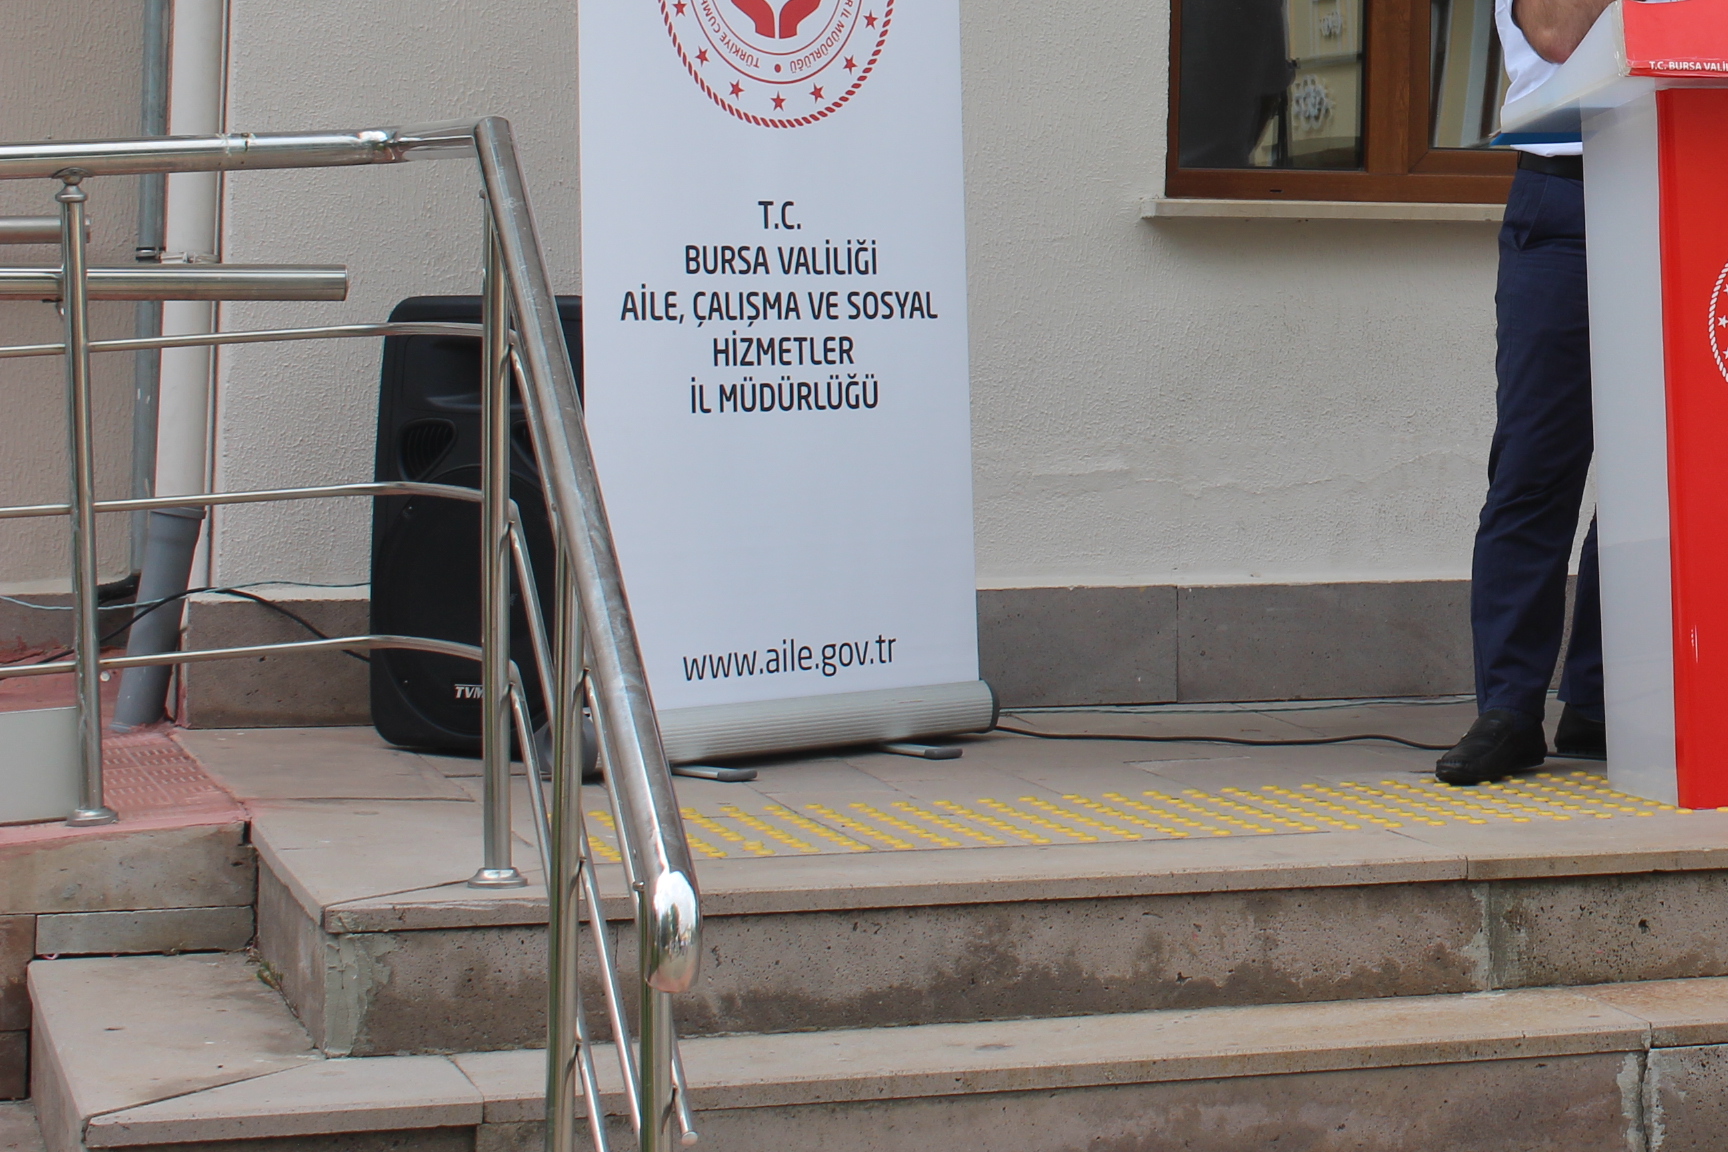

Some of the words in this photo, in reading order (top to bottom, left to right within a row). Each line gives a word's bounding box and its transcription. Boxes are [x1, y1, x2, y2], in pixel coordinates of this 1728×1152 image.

[840, 8, 851, 18] İL
[720, 32, 760, 68] TÜRKİYE
[790, 20, 844, 73] MÜDÜRLÜĞÜ
[1649, 60, 1667, 70] T.C.
[1668, 61, 1702, 70] BURSA
[758, 201, 801, 229] T.C.
[686, 245, 770, 274] BURSA
[778, 239, 876, 275] VALİLİĞİ
[621, 284, 684, 324] AİLE,
[694, 292, 800, 327] ÇALIŞMA
[808, 292, 839, 320] VE
[847, 291, 938, 319] SOSYAL
[714, 330, 854, 366] HİZMETLER
[692, 377, 711, 413] İL
[720, 373, 878, 412] MÜDÜRLÜĞÜ
[683, 635, 896, 681] www.aile.gov.tr
